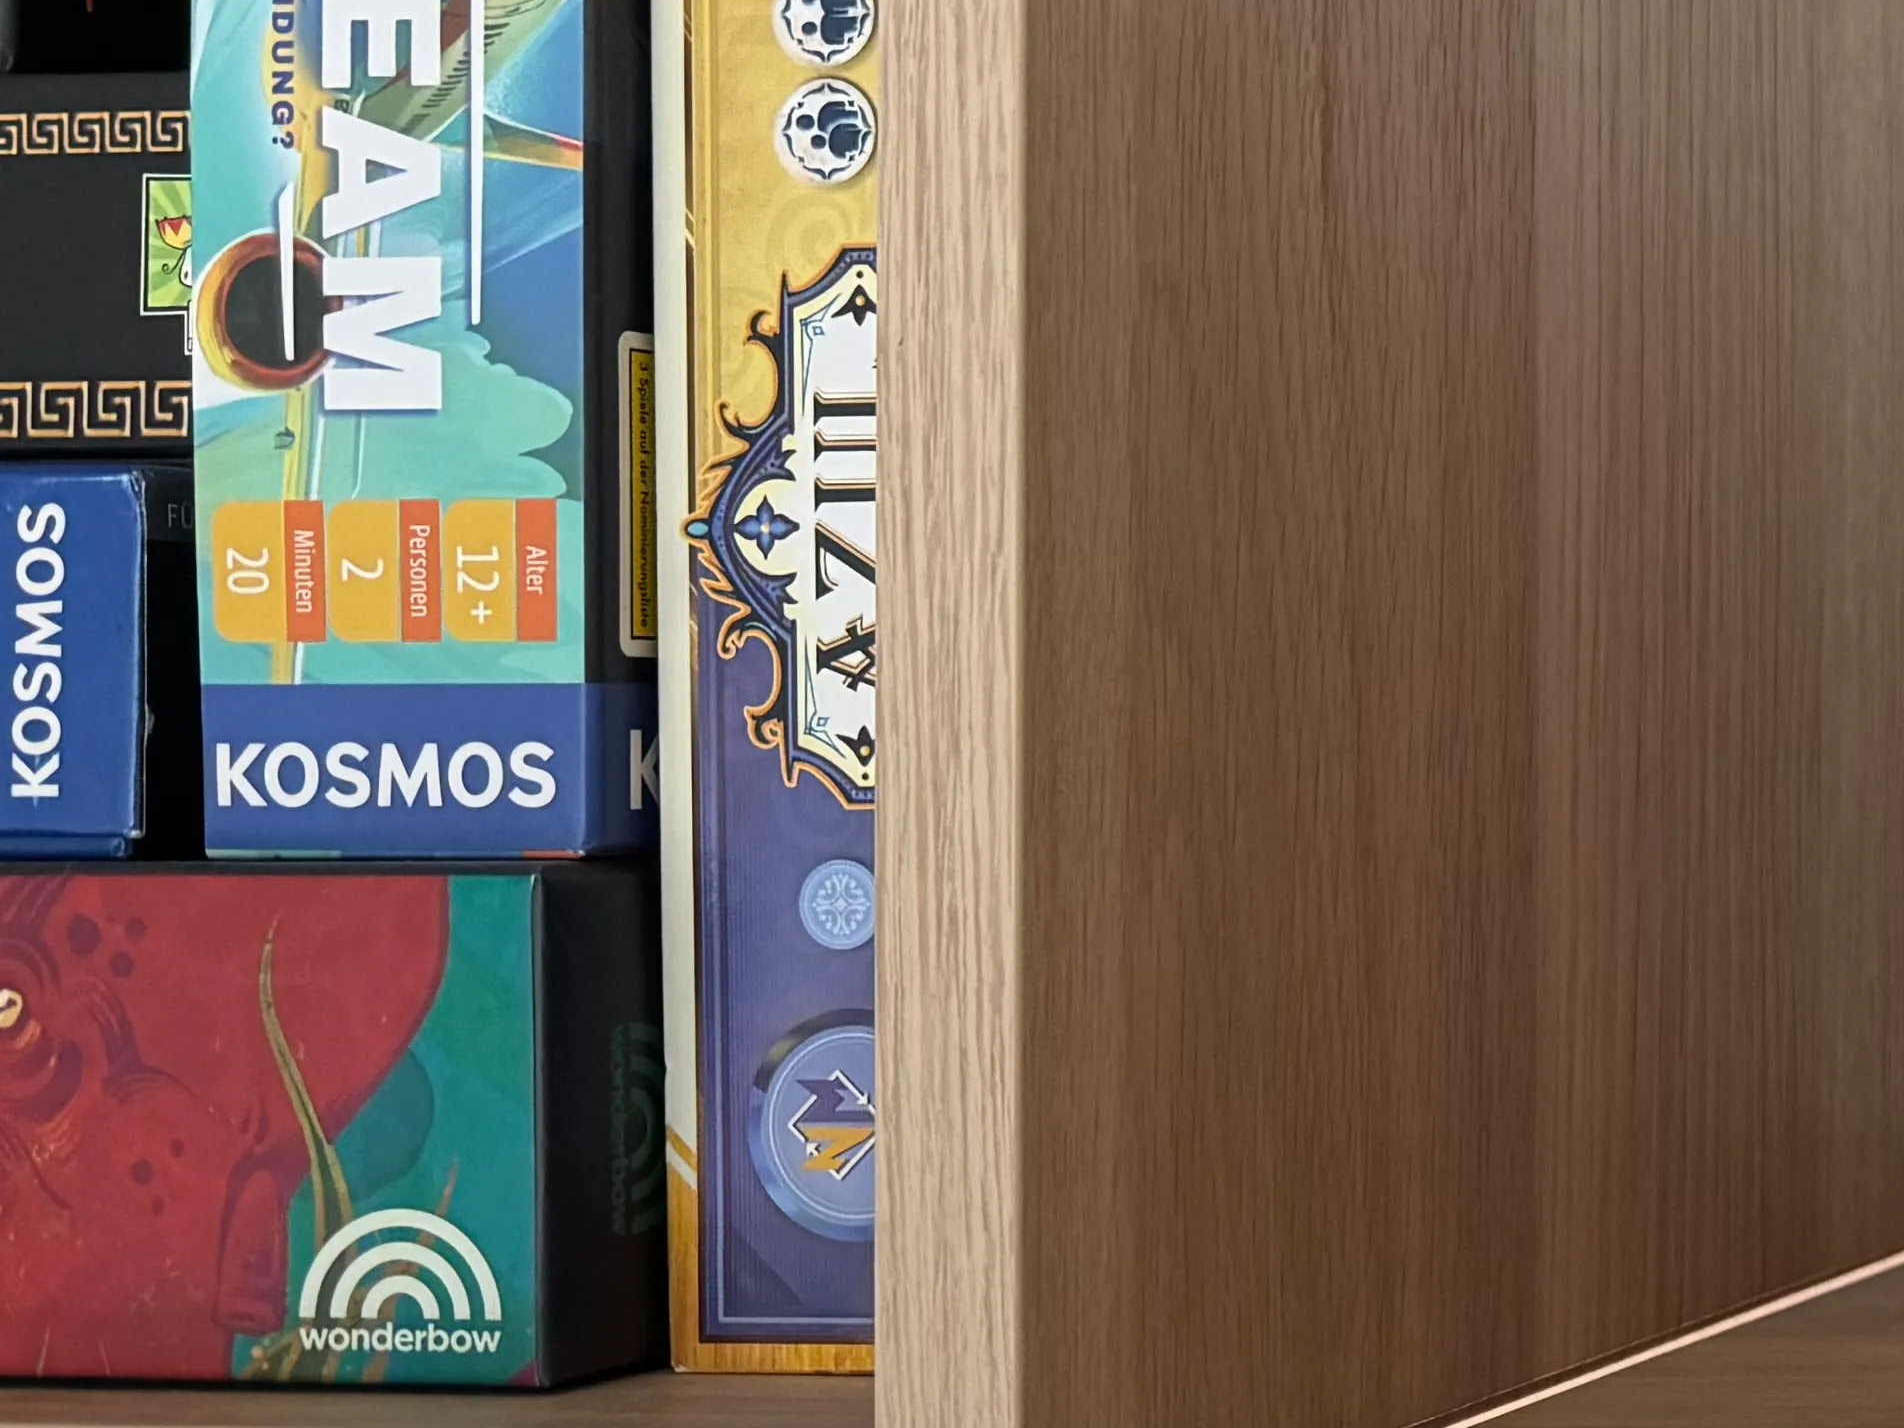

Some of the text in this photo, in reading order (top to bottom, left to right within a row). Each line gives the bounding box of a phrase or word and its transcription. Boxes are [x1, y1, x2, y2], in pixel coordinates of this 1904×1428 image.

[637, 377, 651, 425] Spiele
[637, 429, 651, 455] auf
[637, 459, 651, 485] der
[225, 546, 271, 596] 20
[292, 529, 314, 615] Minuten
[340, 557, 385, 582] 2
[408, 523, 429, 619] Personen
[454, 544, 500, 627] 12+
[525, 544, 547, 597] Alter
[10, 502, 67, 799] KOSMOS
[214, 741, 557, 810] KOSMOS
[299, 1322, 502, 1355] wonderbow
